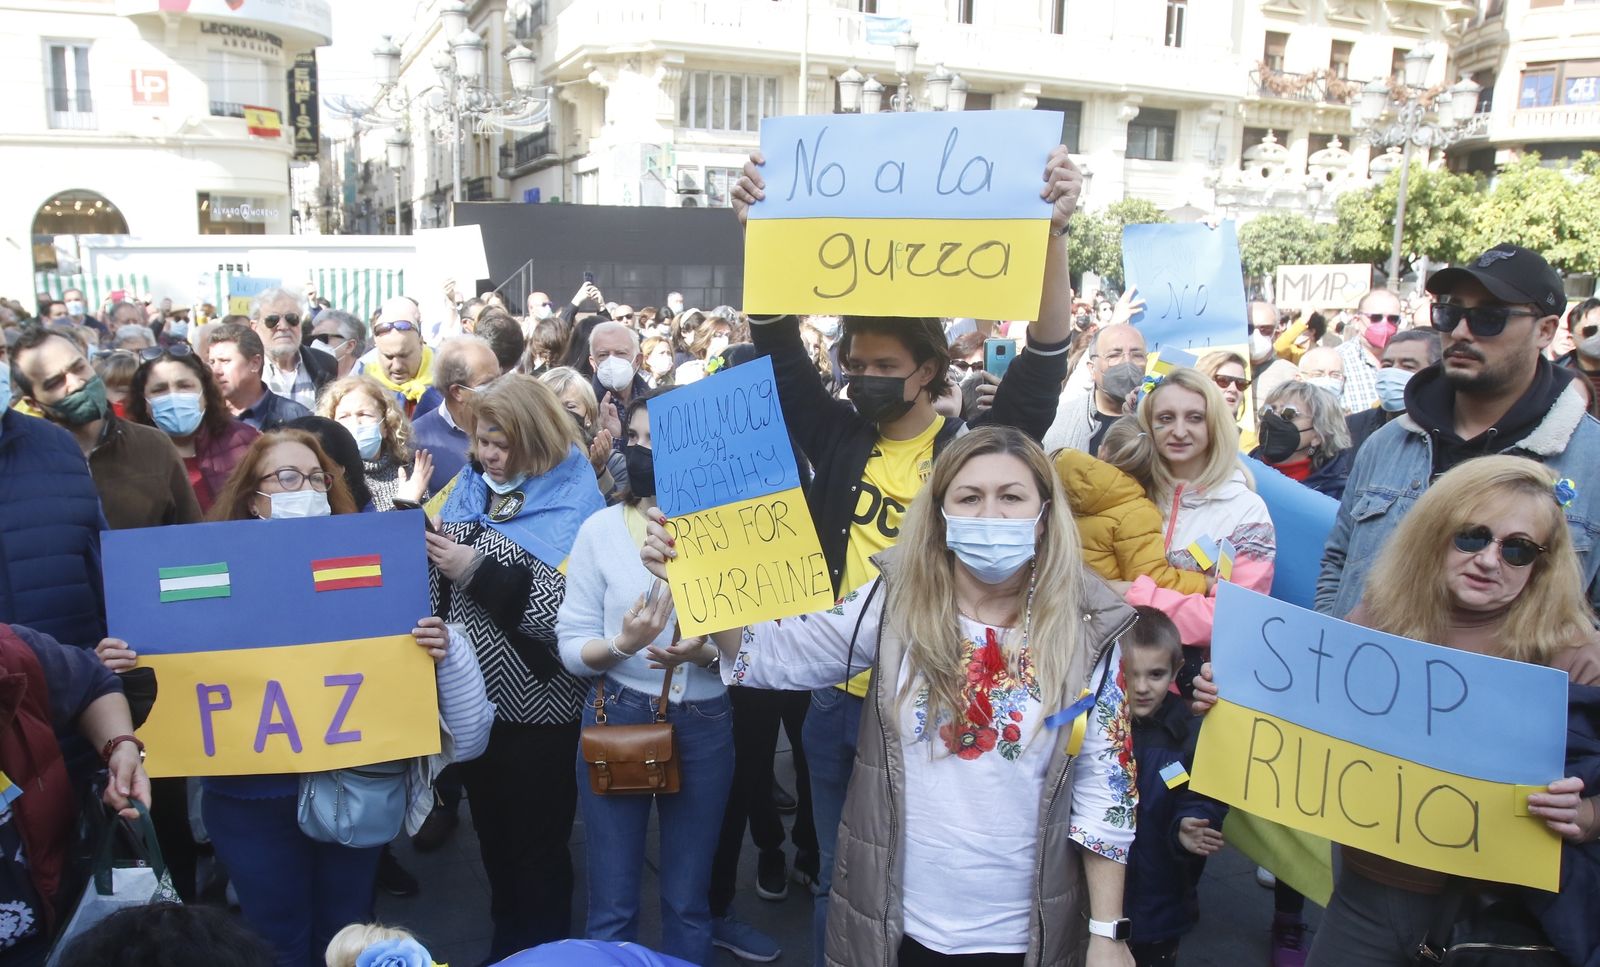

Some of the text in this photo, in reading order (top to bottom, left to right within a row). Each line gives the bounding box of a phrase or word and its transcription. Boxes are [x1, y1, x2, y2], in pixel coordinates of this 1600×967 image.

[294, 67, 313, 140] EMFISA
[786, 126, 995, 202] No a la
[212, 207, 240, 216] ALVARO
[250, 207, 279, 218] MORENO
[1160, 281, 1209, 321] NO
[1282, 273, 1349, 302] МИР
[654, 379, 780, 462] МОЛИМОСЯ
[658, 445, 786, 515] УКРАЇНУ
[664, 500, 797, 563] PRAY FOR
[682, 552, 831, 624] UKRAINE
[195, 672, 365, 757] PAZ
